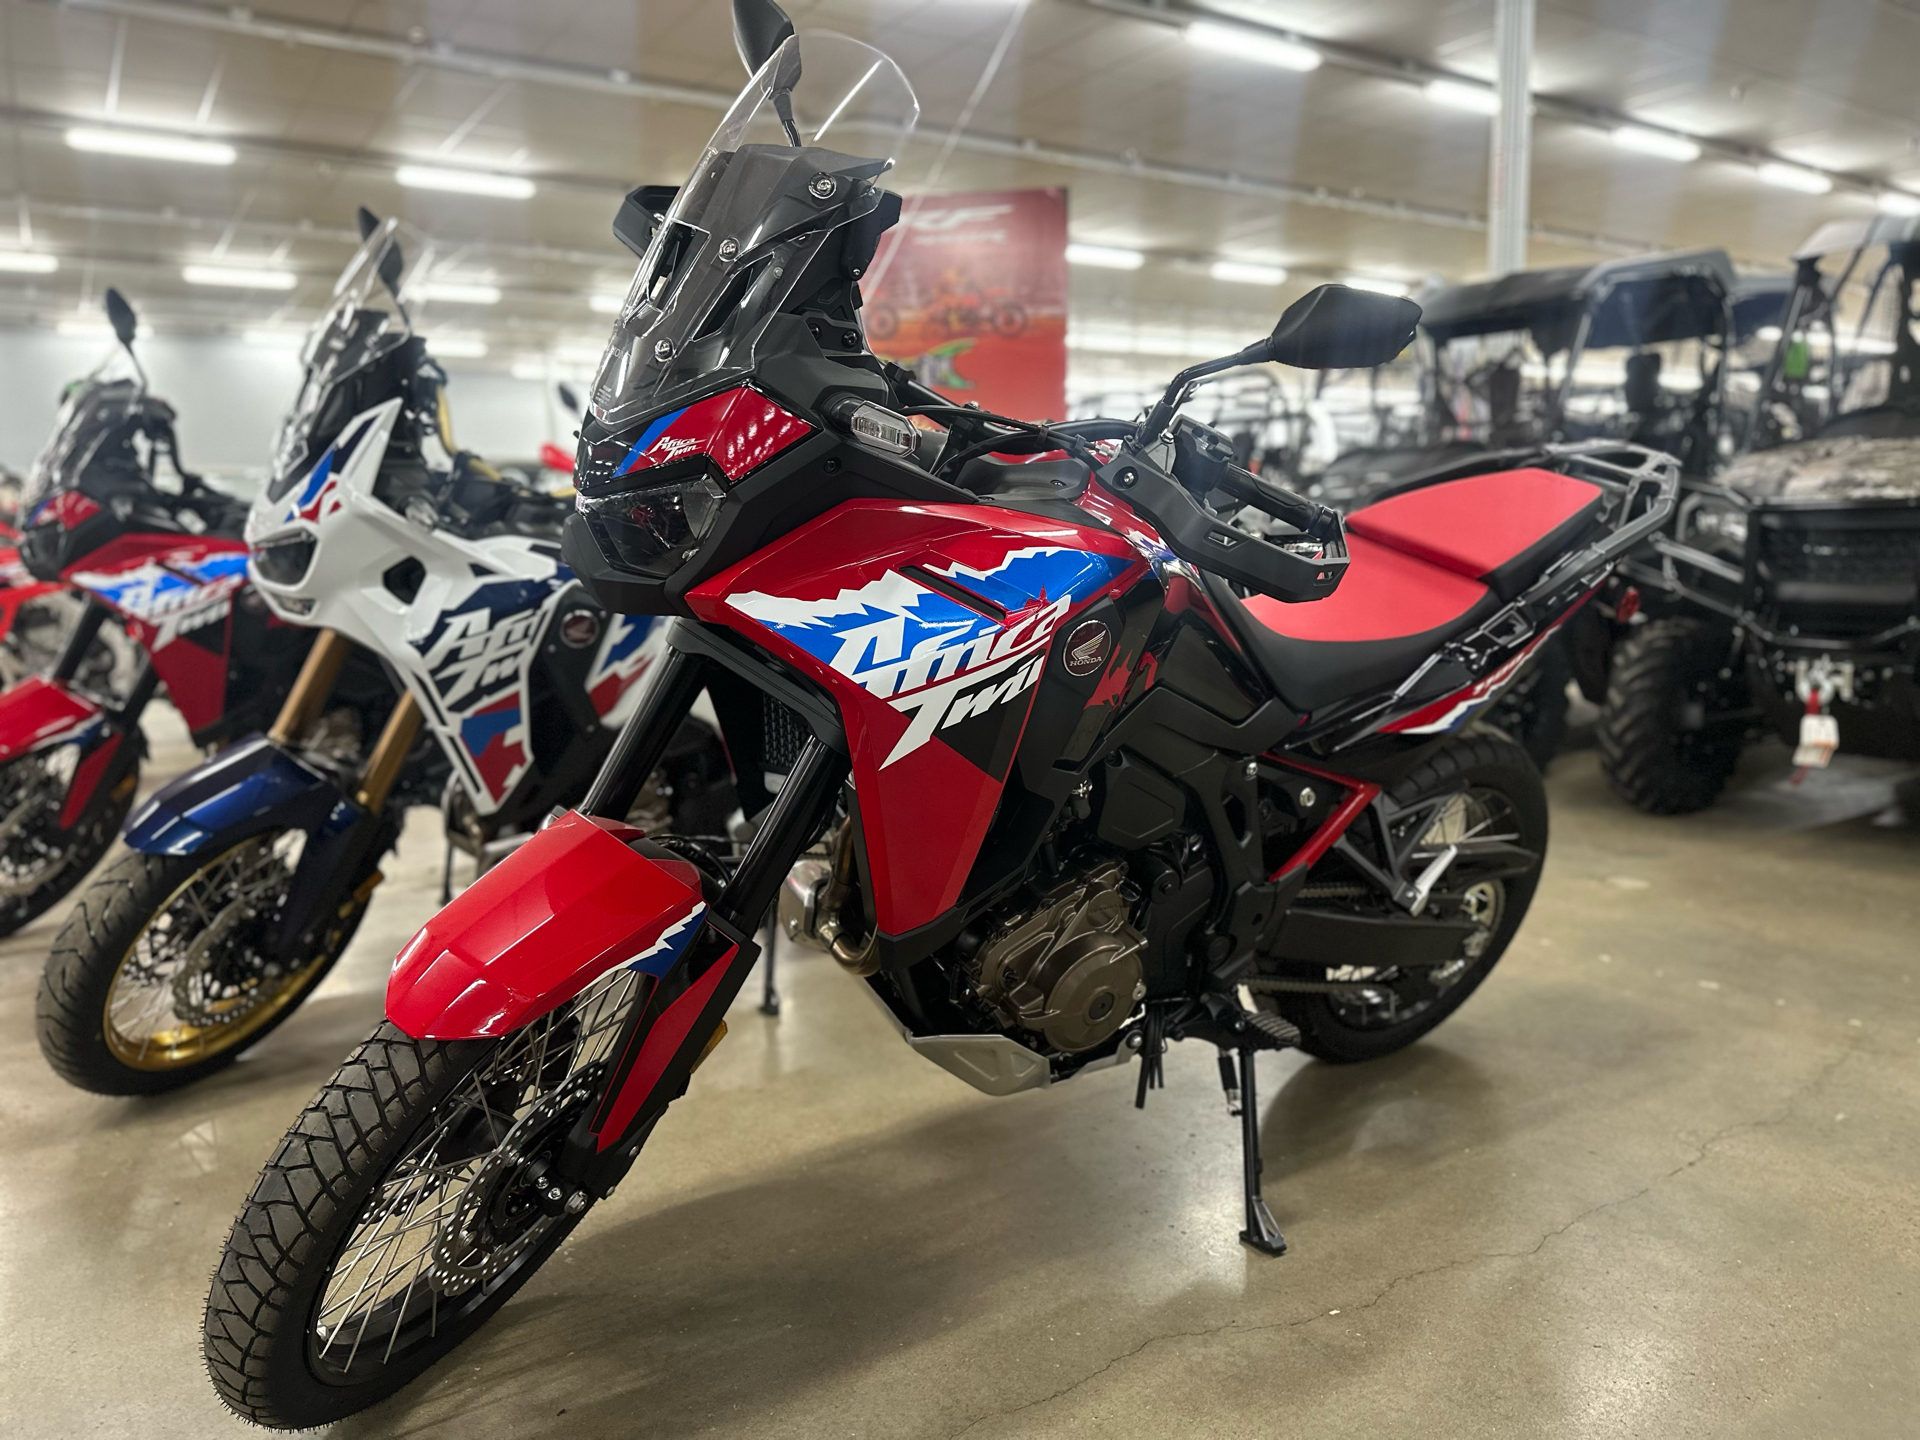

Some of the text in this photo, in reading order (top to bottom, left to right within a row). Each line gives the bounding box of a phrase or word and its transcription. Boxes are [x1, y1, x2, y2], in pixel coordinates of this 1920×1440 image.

[646, 436, 706, 455] Africa
[662, 443, 702, 463] Twin
[828, 594, 1071, 700] Africa
[1069, 656, 1103, 667] HONDA
